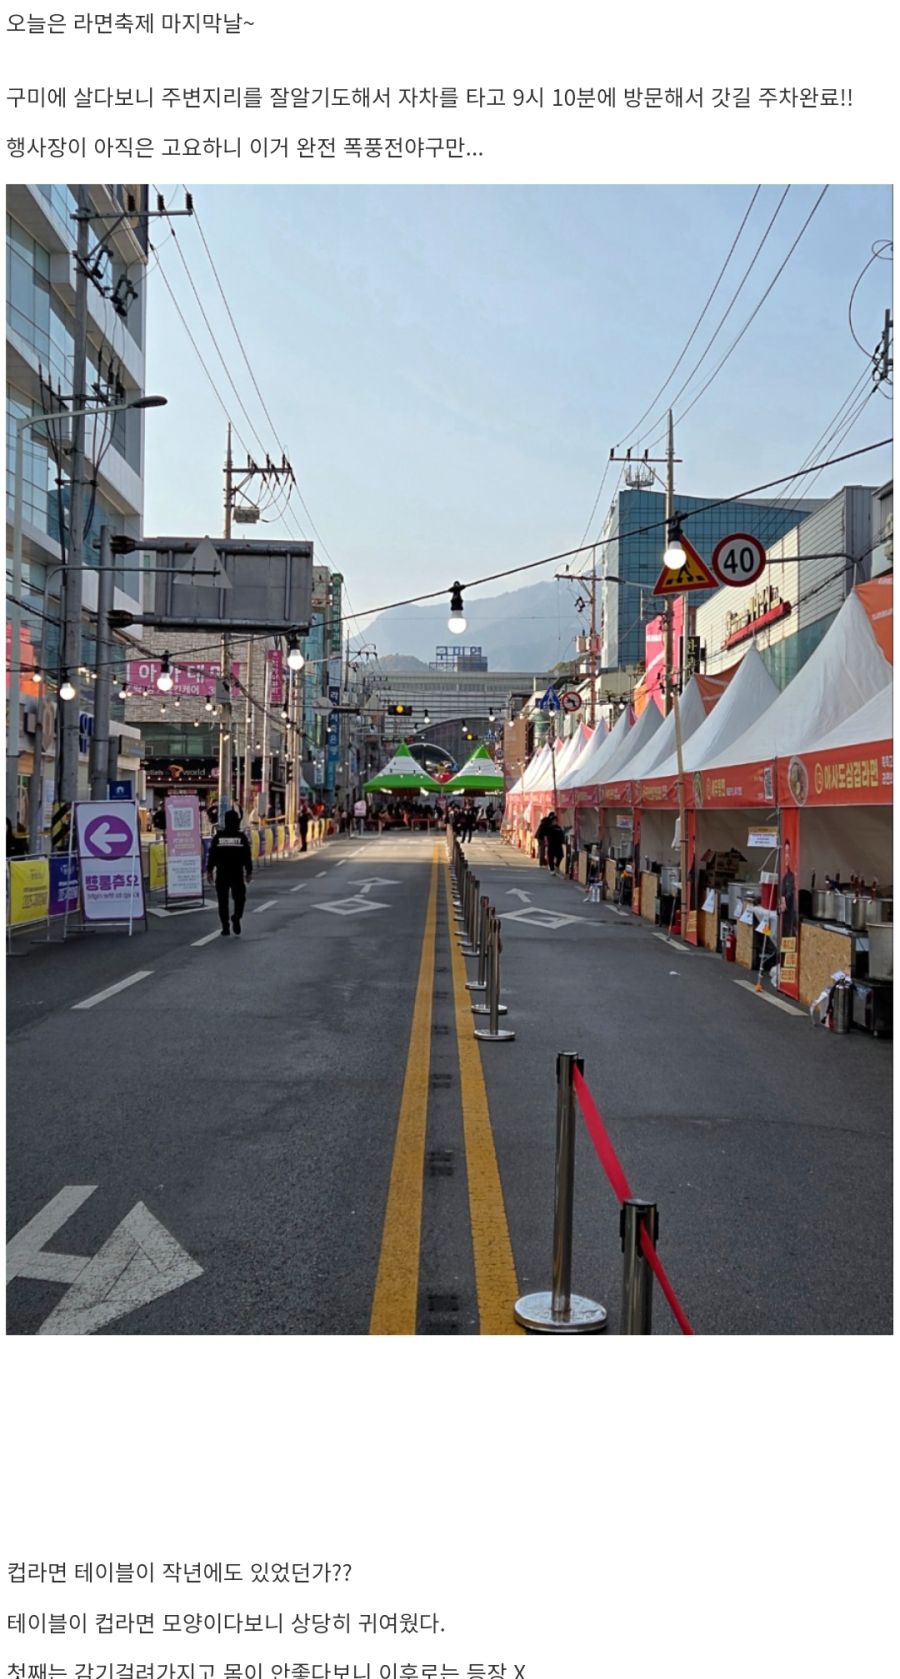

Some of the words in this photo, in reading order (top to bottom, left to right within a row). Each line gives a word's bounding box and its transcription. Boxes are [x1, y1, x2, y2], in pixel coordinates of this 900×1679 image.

[724, 547, 754, 574] 40
[436, 646, 482, 660] 구미역
[218, 837, 241, 845] SECURITY
